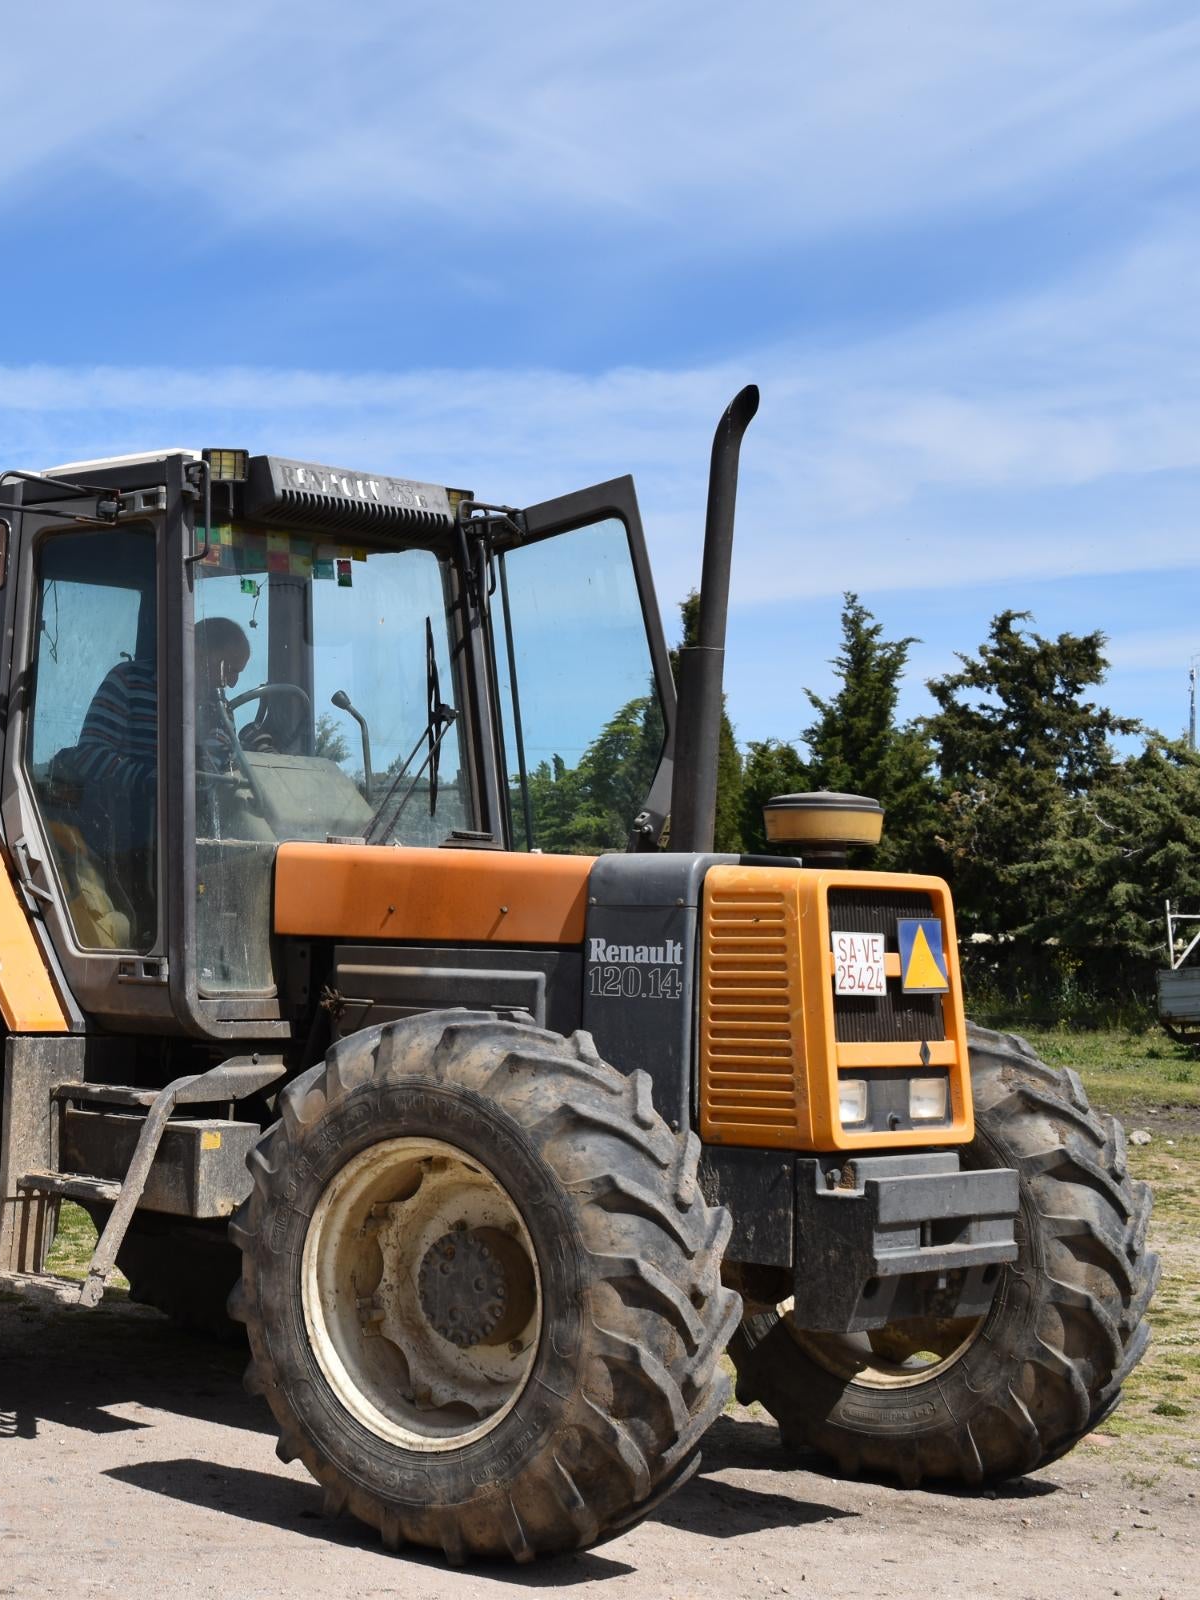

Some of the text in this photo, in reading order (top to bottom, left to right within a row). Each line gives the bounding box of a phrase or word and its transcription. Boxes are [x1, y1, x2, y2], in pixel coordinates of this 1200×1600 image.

[280, 464, 380, 501] RENAULT
[588, 938, 683, 965] Renault
[589, 965, 682, 999] 120.14
[838, 964, 883, 992] 25424
